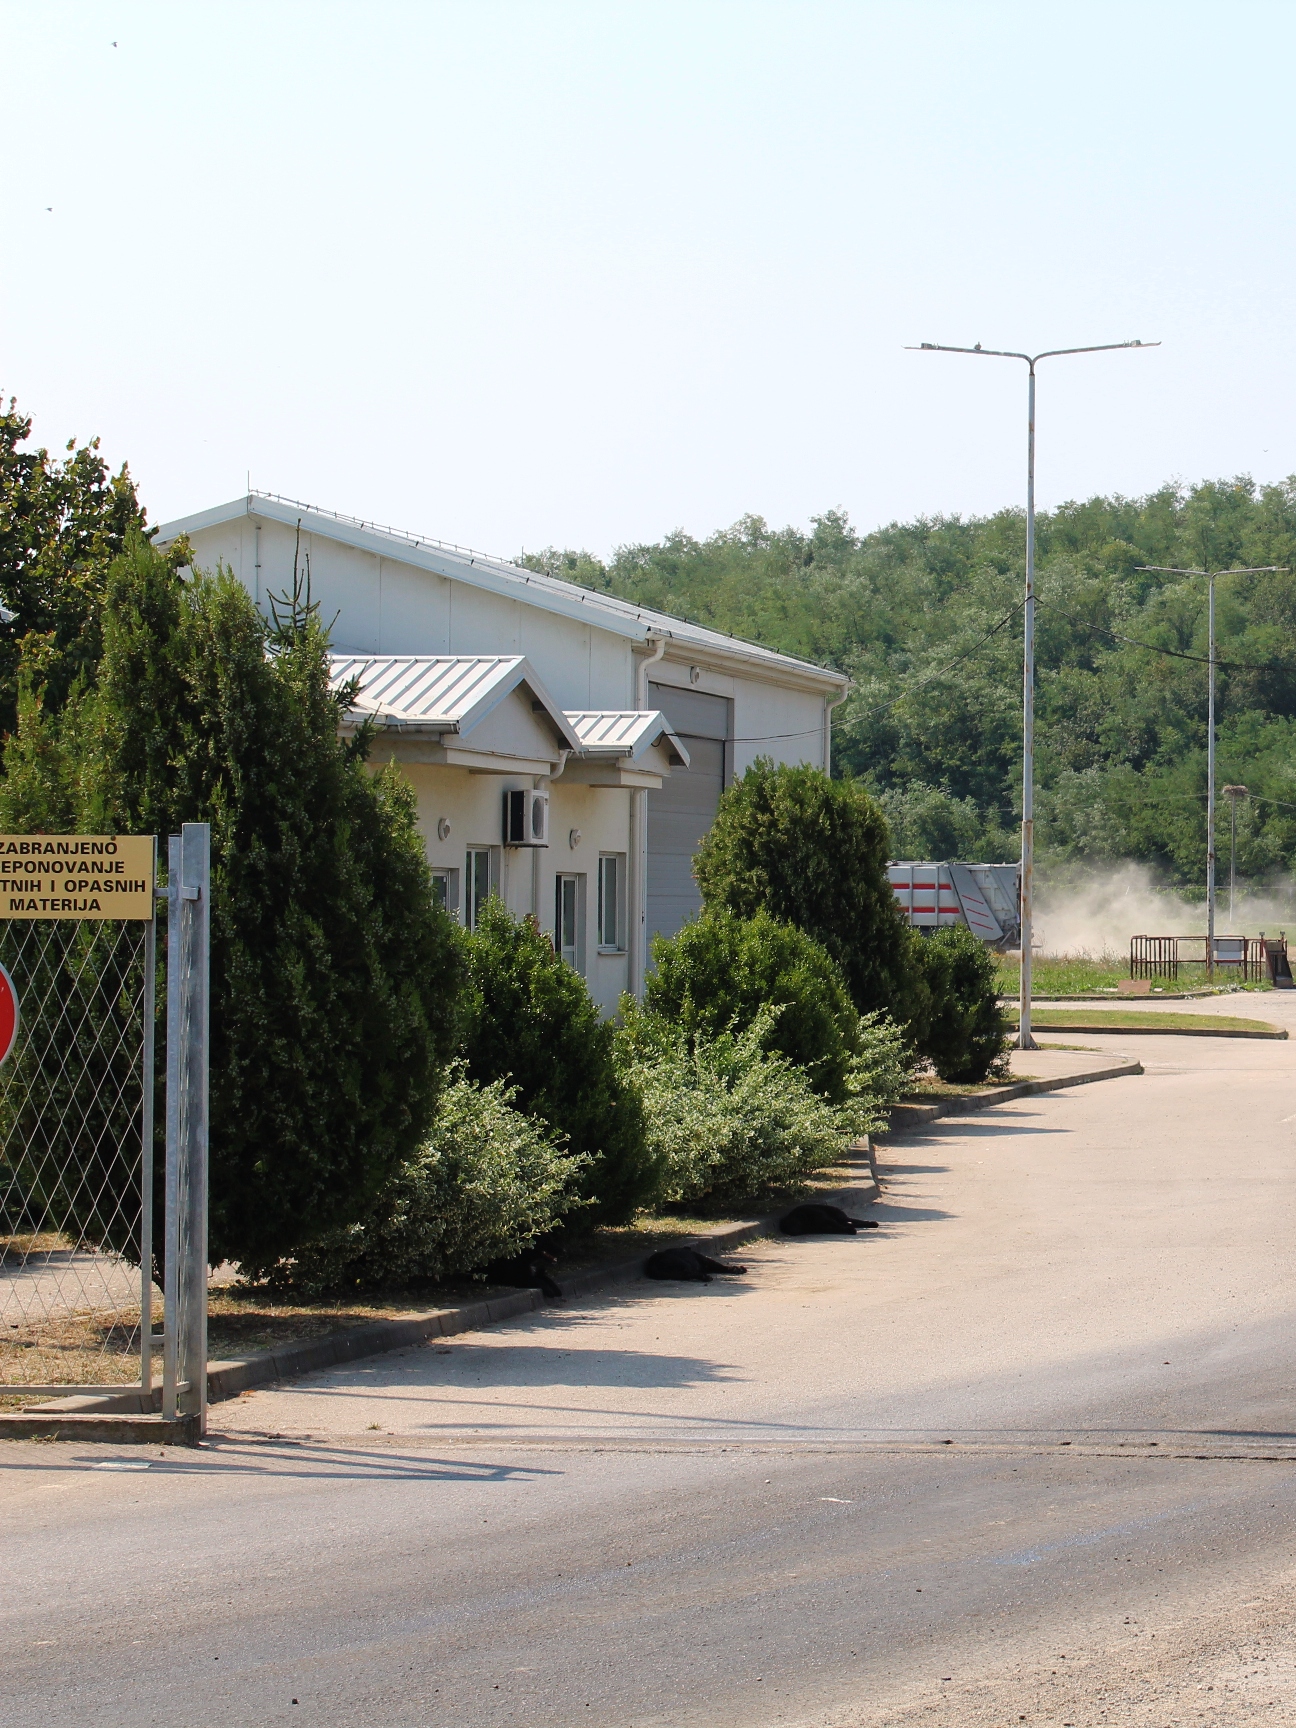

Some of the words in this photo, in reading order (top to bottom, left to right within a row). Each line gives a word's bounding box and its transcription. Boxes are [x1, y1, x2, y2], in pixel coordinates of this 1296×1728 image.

[51, 879, 55, 892] I
[64, 879, 146, 893] OPASNIH
[9, 898, 101, 911] MATERIJA
